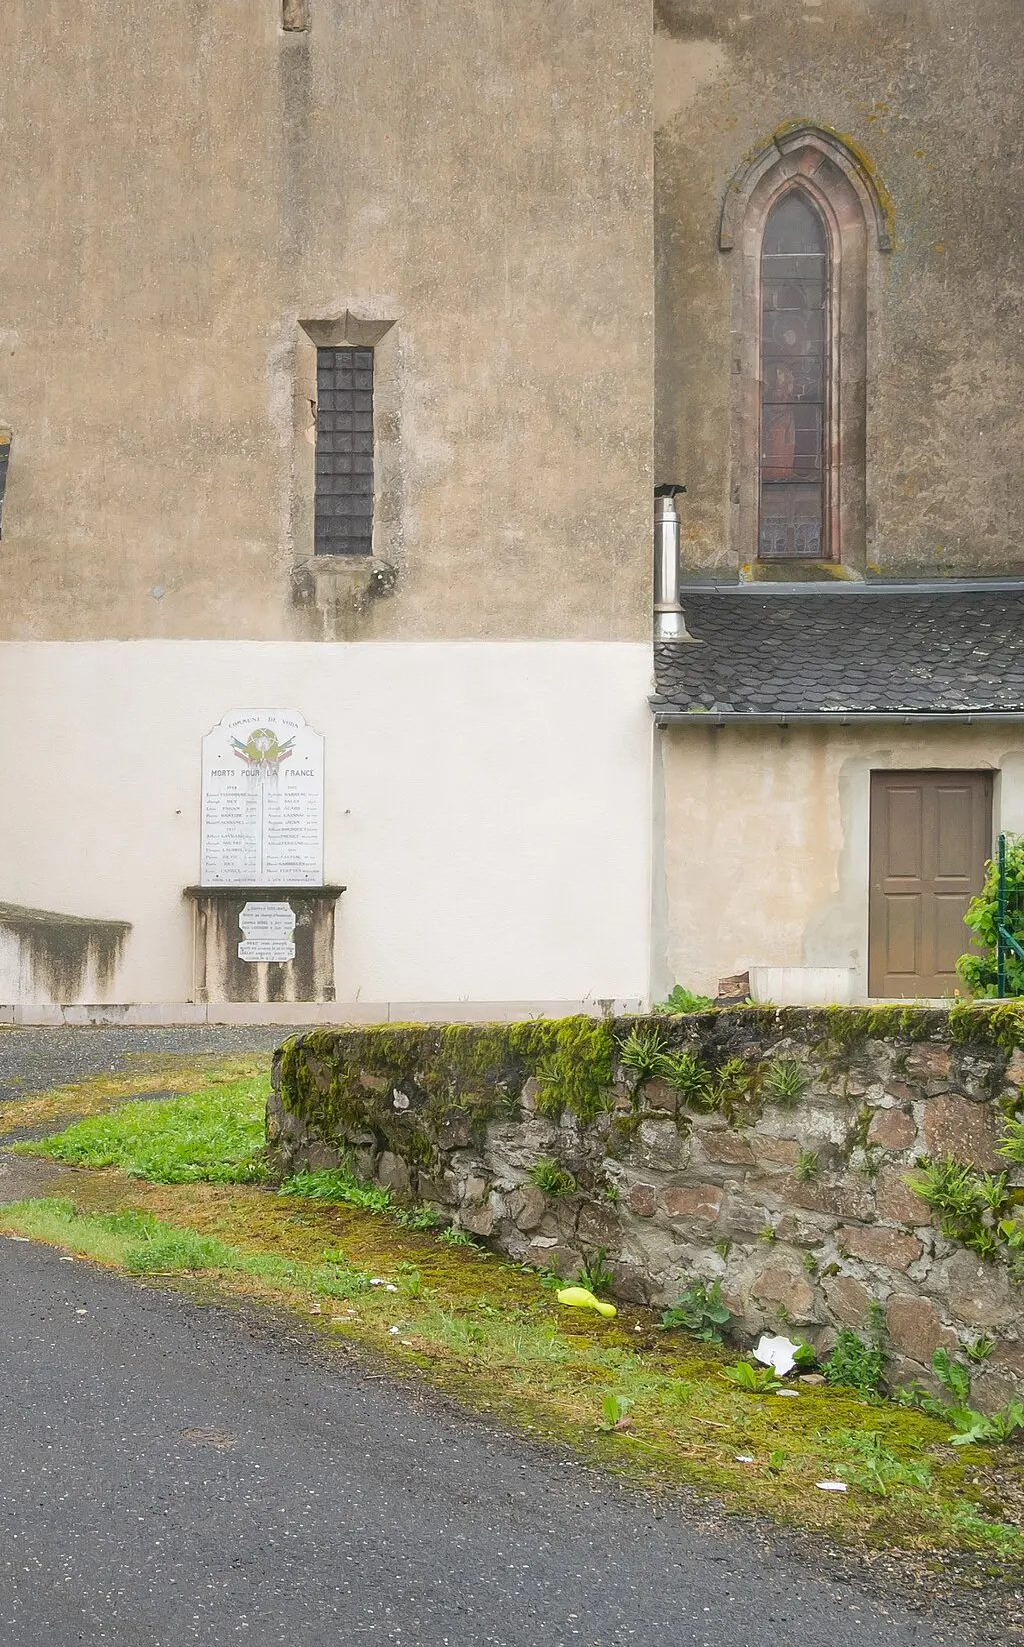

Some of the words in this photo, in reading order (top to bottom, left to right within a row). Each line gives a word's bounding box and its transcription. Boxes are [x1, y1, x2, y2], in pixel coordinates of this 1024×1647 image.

[211, 769, 235, 777] MORTS
[241, 769, 260, 777] POUR
[266, 769, 278, 777] LA
[285, 769, 315, 777] FRANCE
